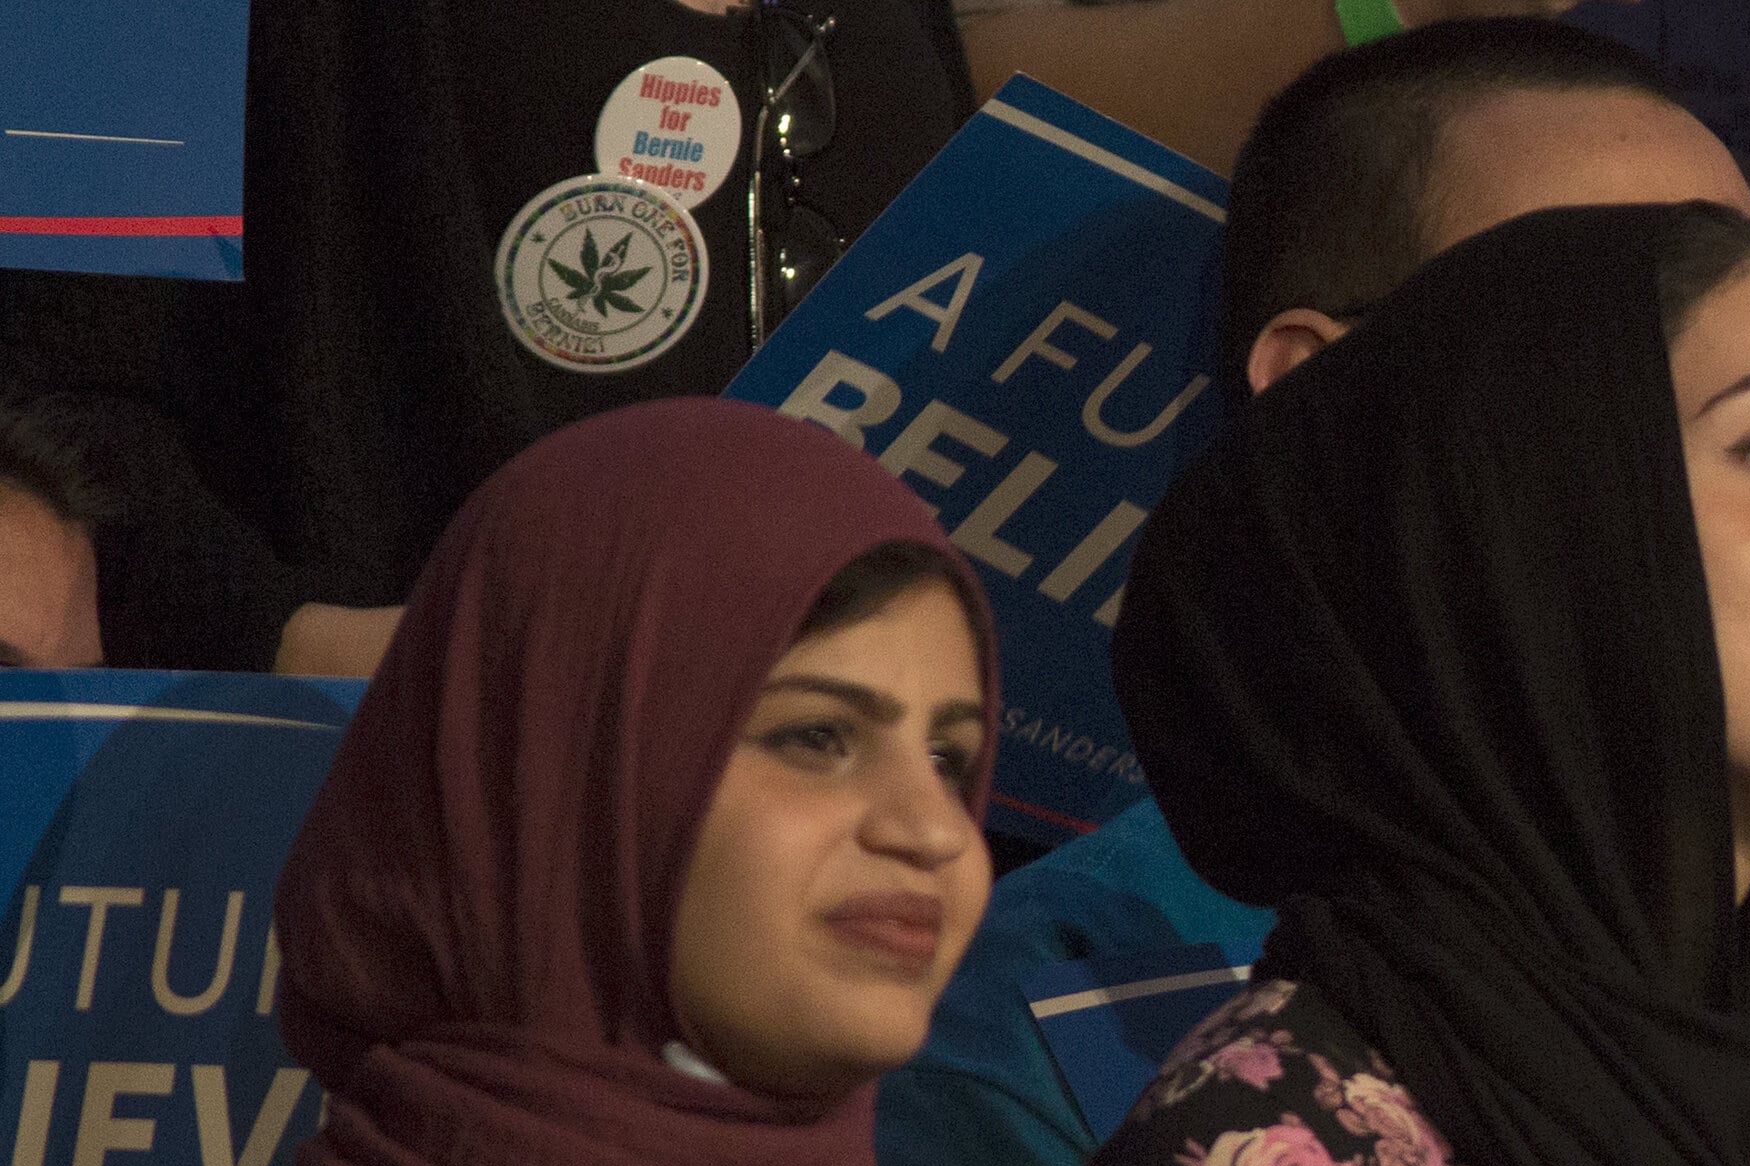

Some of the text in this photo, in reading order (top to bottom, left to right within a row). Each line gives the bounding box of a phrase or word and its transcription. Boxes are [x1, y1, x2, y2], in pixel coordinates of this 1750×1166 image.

[639, 73, 722, 107] Hippies
[659, 105, 692, 132] for
[632, 130, 704, 163] Bernie
[619, 157, 707, 192] Sanders
[666, 237, 691, 283] FOR
[865, 252, 985, 354] A
[776, 349, 1150, 628] BELI
